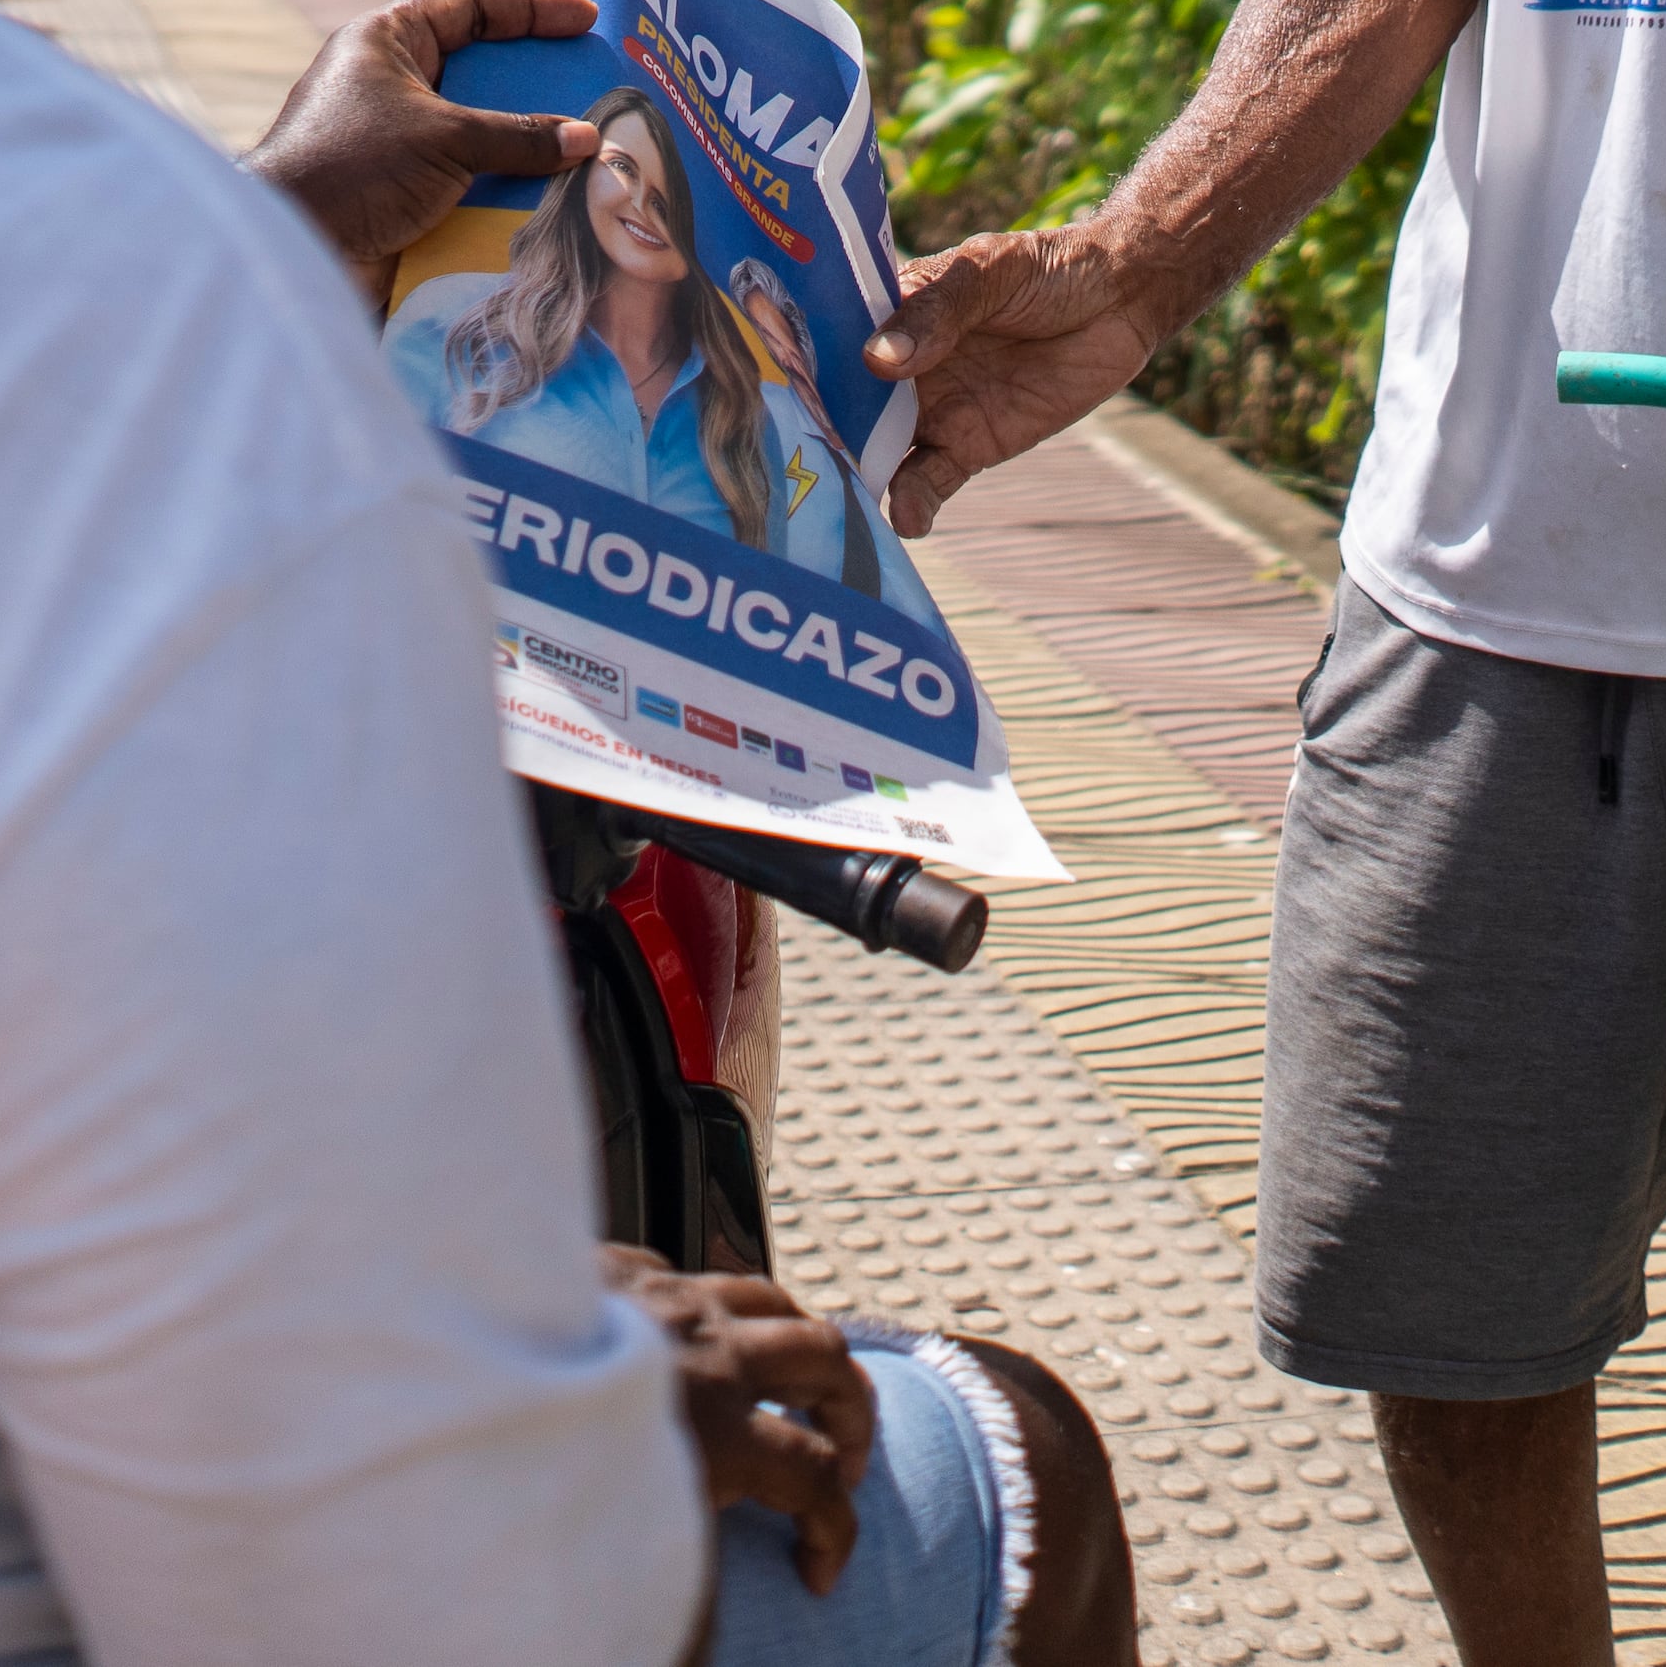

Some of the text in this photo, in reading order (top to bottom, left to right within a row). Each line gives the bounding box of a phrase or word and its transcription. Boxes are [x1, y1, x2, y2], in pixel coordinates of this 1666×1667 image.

[637, 13, 790, 212] PRESIDENTA
[641, 53, 796, 249] COLOMBIA MÁS GRANDE
[451, 472, 956, 718] ERIODICAZO
[524, 635, 619, 683] CENTRO
[494, 694, 608, 750] SÍGUENOS
[612, 738, 643, 762] EN
[648, 752, 723, 787] REDES
